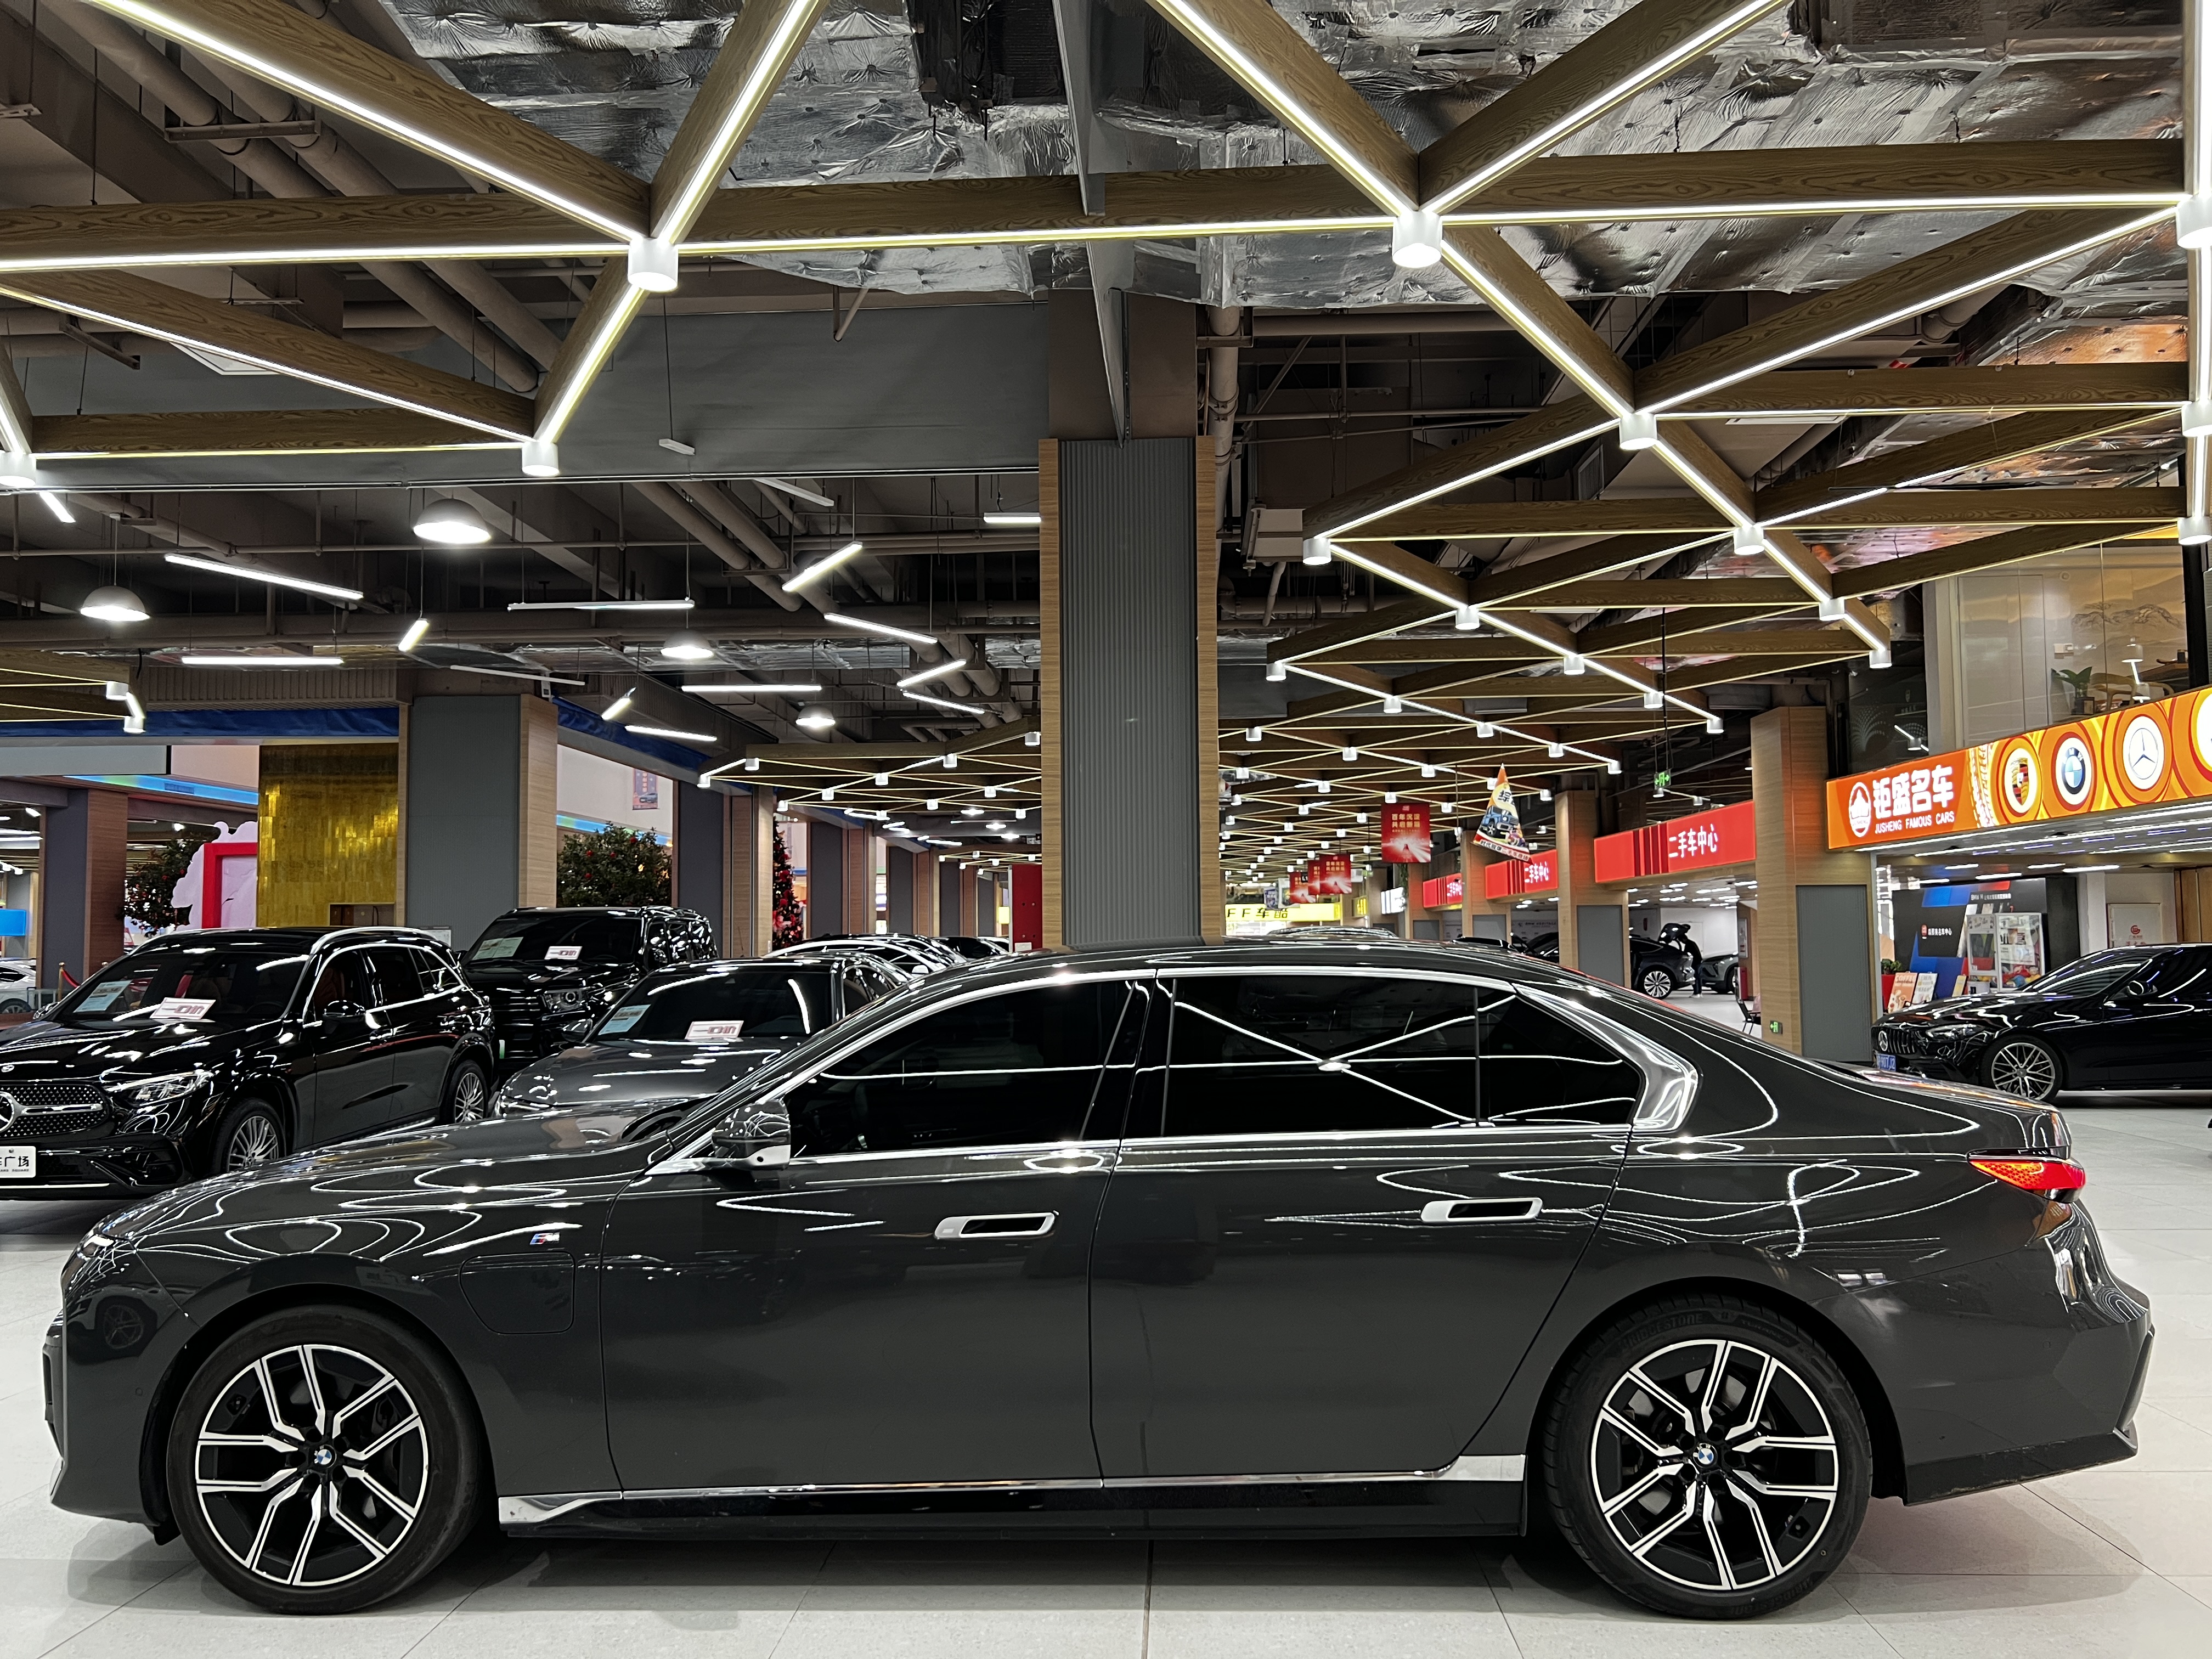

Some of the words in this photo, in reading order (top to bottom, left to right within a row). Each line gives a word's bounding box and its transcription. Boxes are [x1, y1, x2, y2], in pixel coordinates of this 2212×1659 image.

[1872, 764, 1954, 819] 钜盛名车
[1875, 819, 1902, 834] JUSHENG
[1905, 815, 1932, 829] FAMOUS
[1936, 811, 1955, 825] CARS
[1668, 823, 1718, 858] 二手车中心
[1524, 861, 1549, 883] 二手车中心
